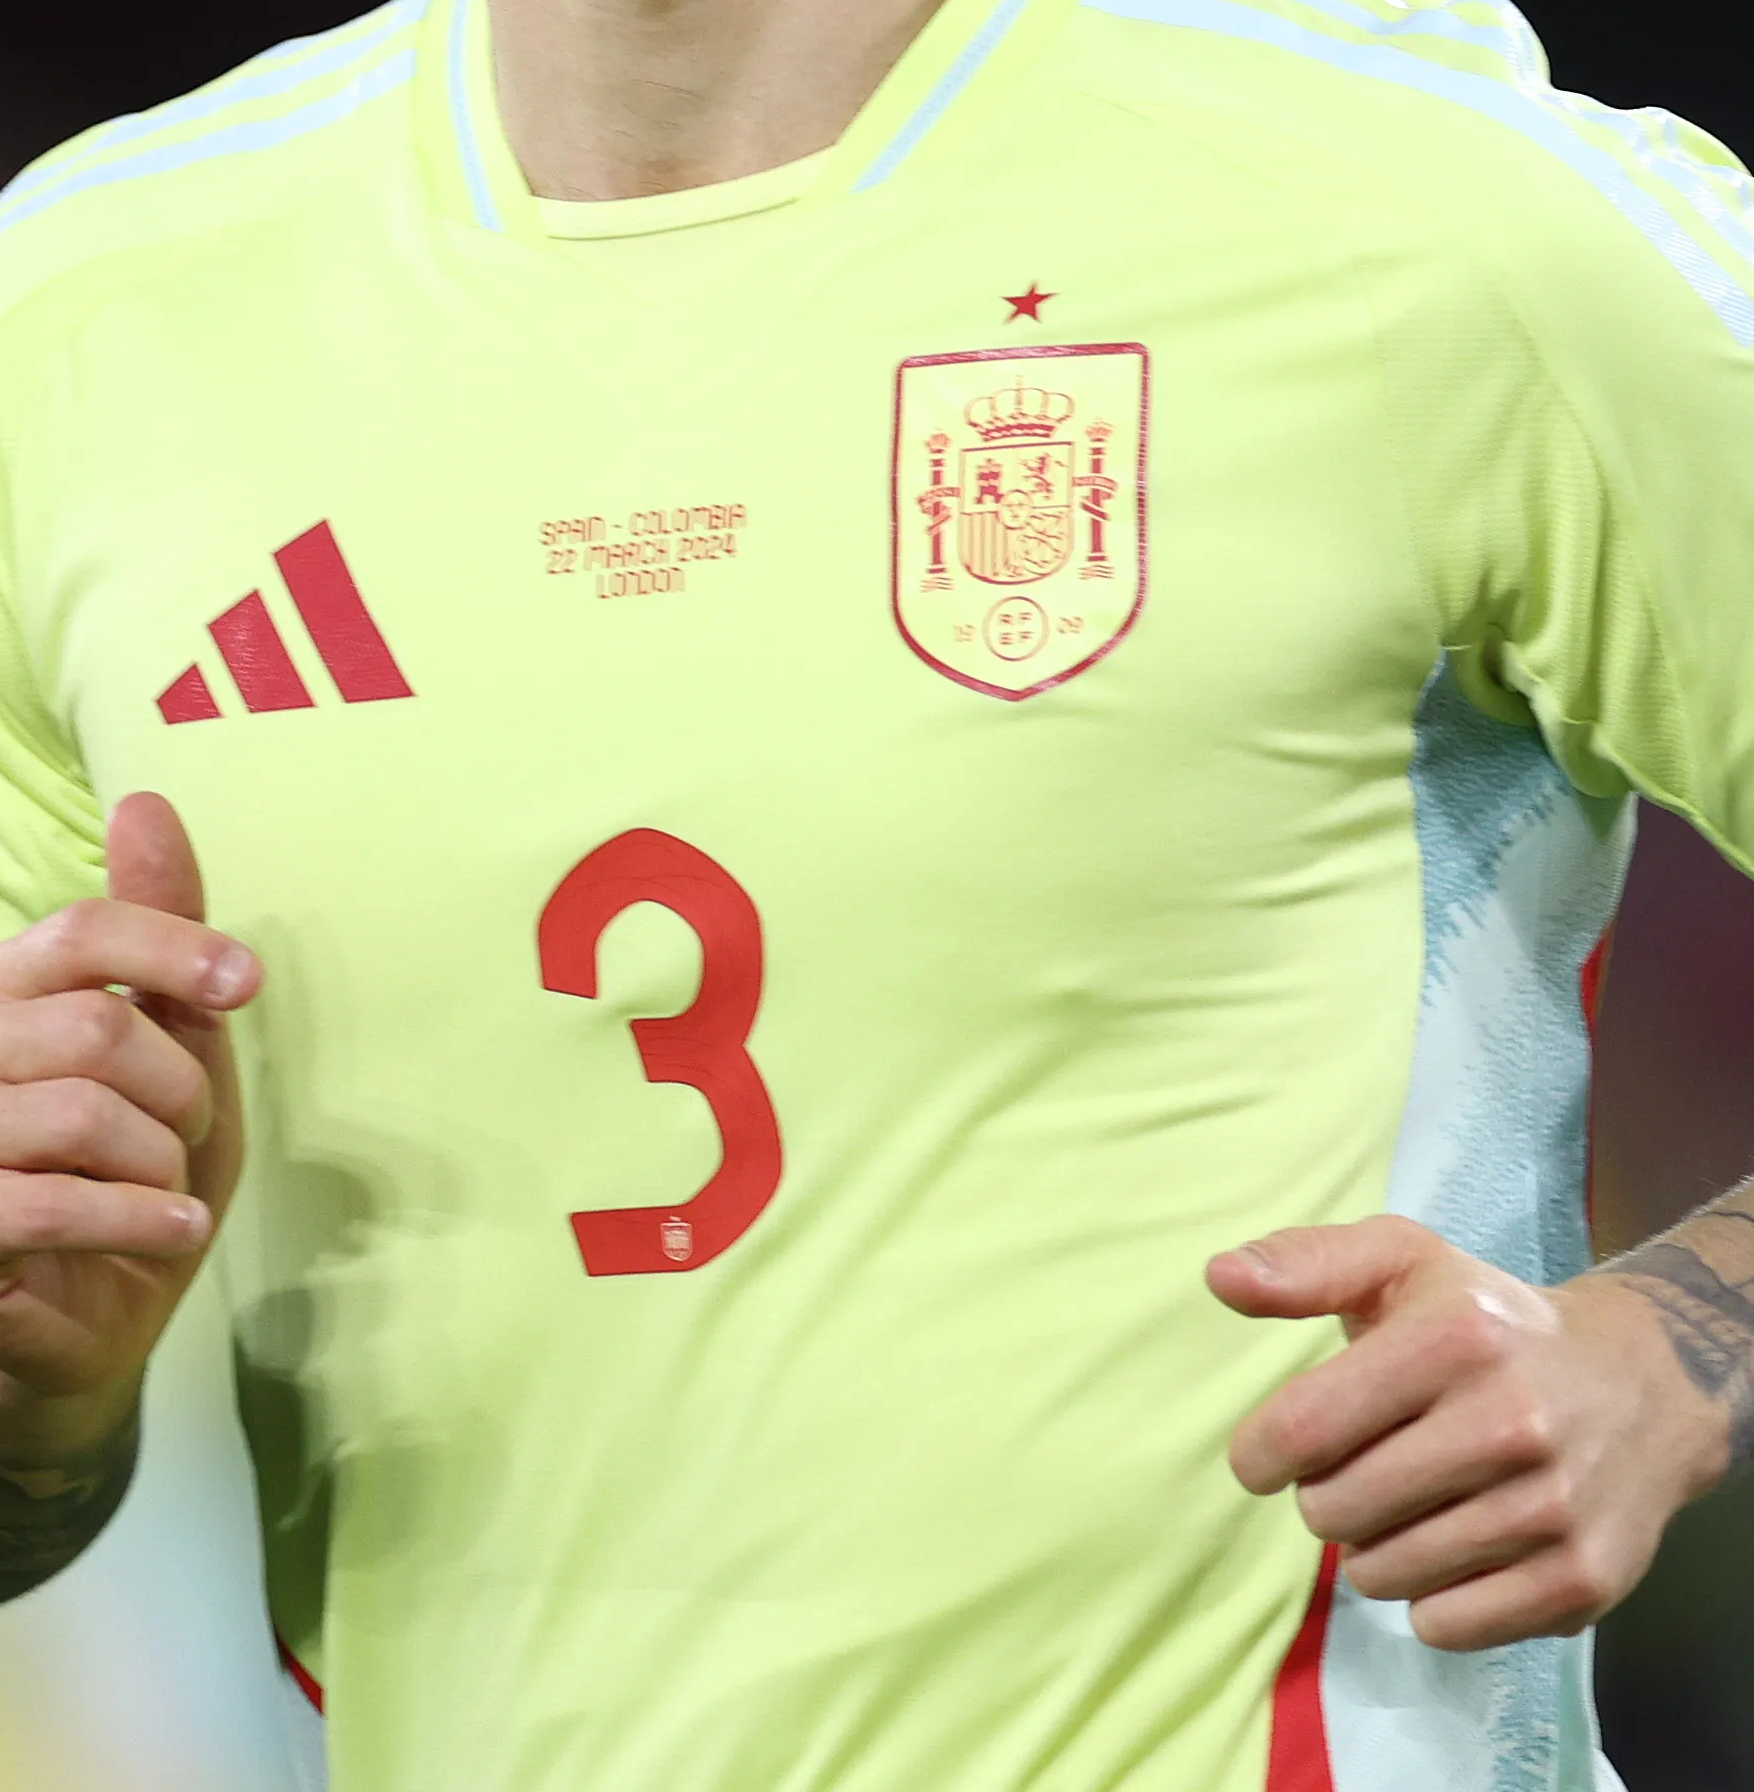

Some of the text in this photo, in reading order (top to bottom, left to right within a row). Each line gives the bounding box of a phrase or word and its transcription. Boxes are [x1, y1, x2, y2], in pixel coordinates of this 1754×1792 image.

[538, 516, 606, 546] SPAIN
[628, 503, 747, 537] COLOMBIA
[545, 533, 738, 575] 22 MARCH 2024
[596, 567, 685, 599] LONDON
[537, 826, 784, 1278] 3
